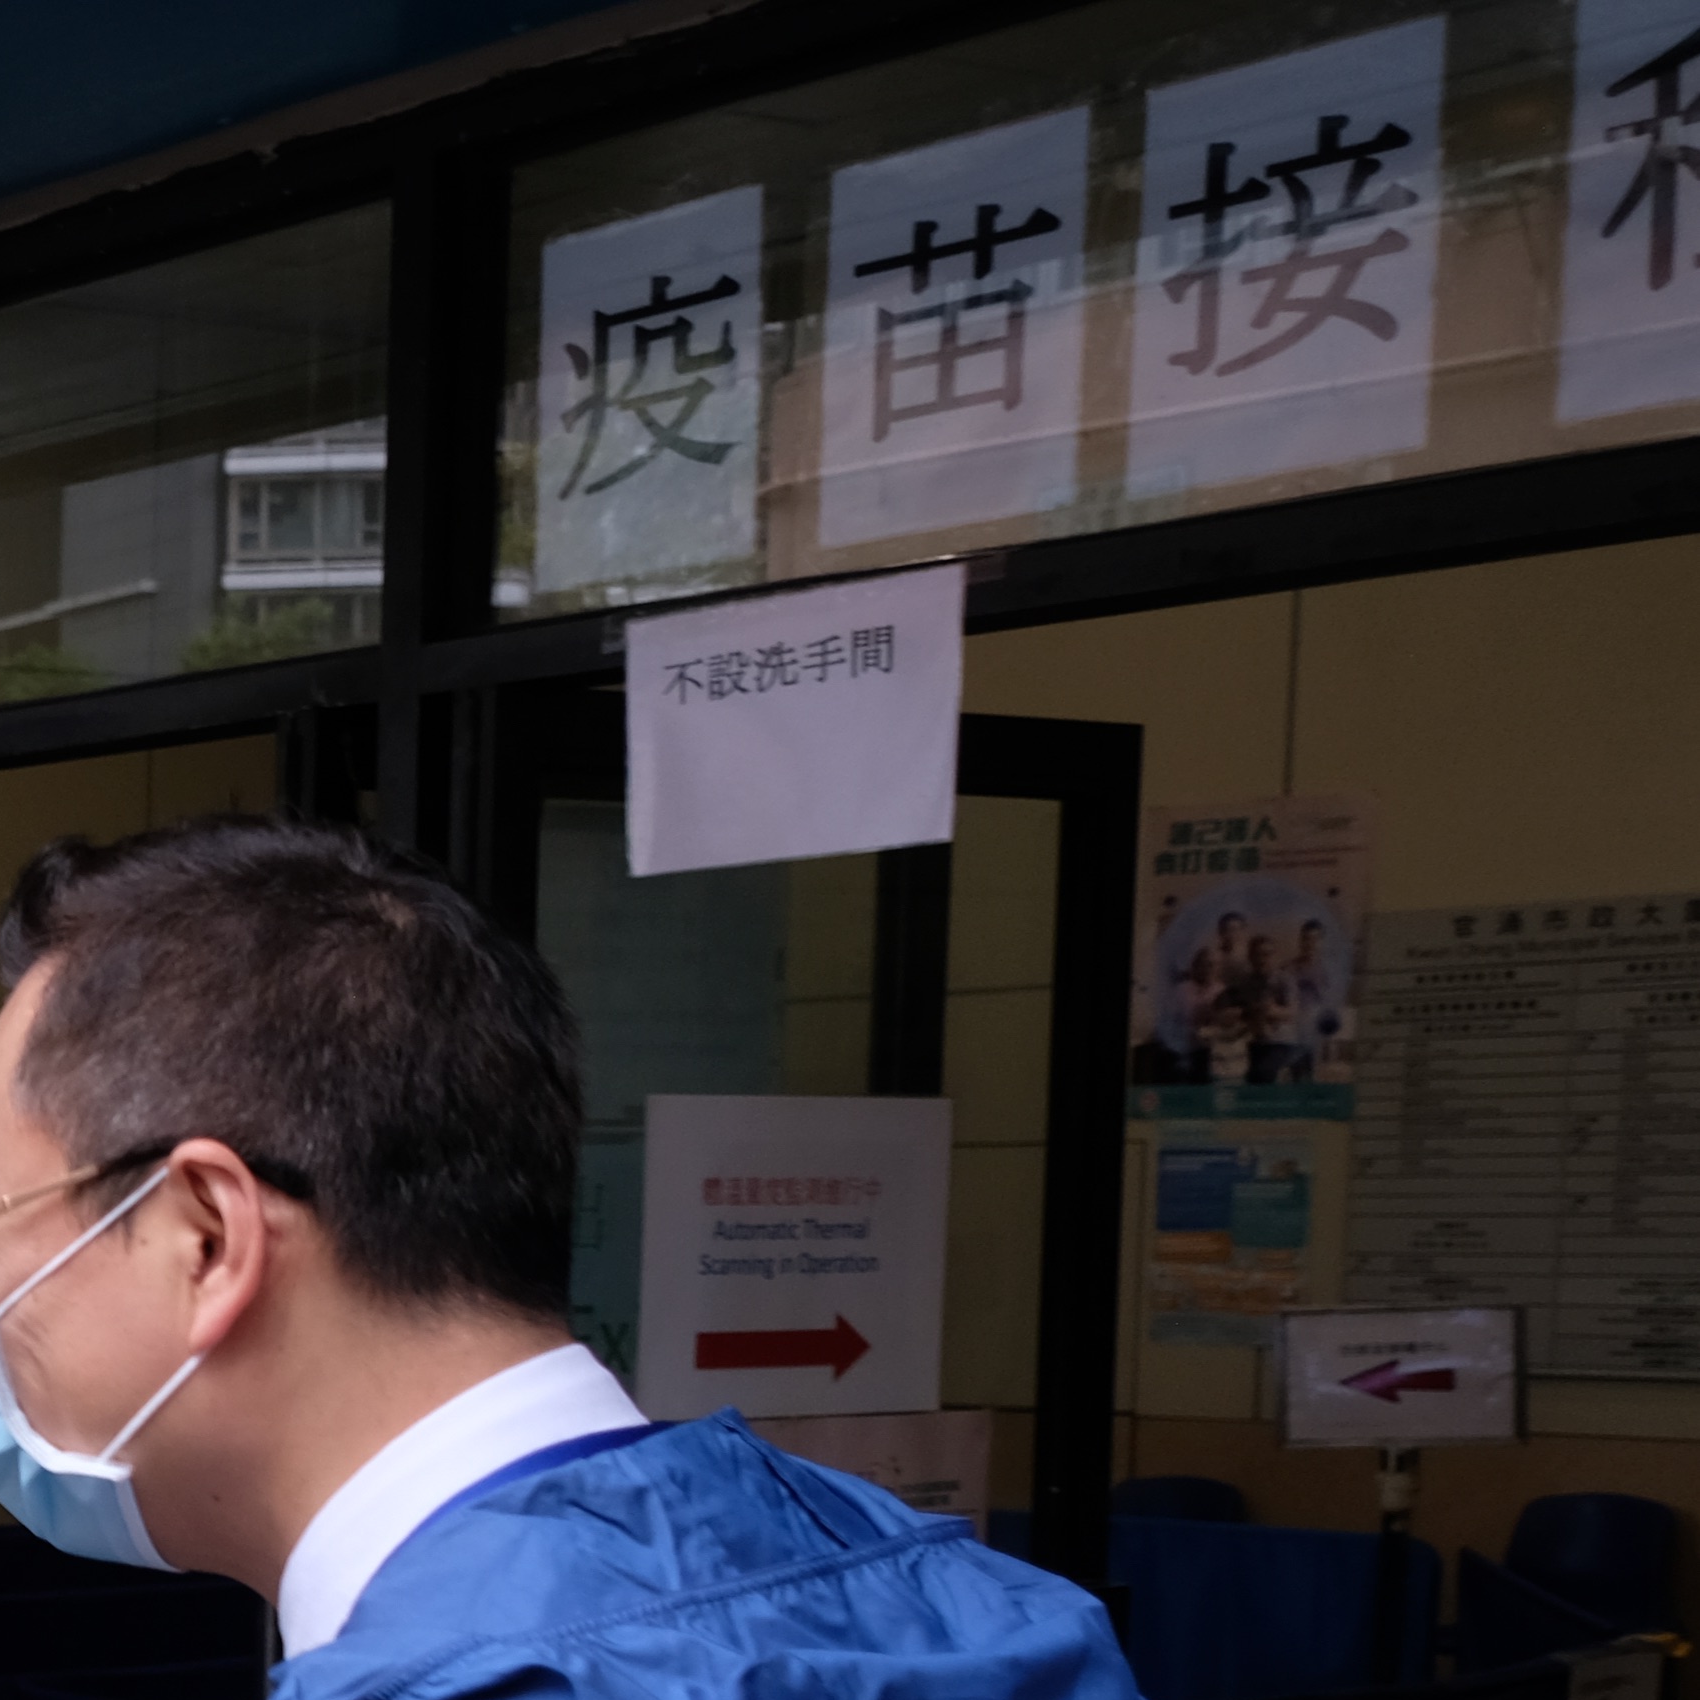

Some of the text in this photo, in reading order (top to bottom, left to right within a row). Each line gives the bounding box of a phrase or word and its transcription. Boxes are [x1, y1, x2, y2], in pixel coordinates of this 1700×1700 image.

[663, 624, 896, 705] 不設洗手間
[713, 1217, 871, 1241] Automatic Thermal
[698, 1254, 775, 1279] Scanning
[798, 1252, 880, 1277] Operation
